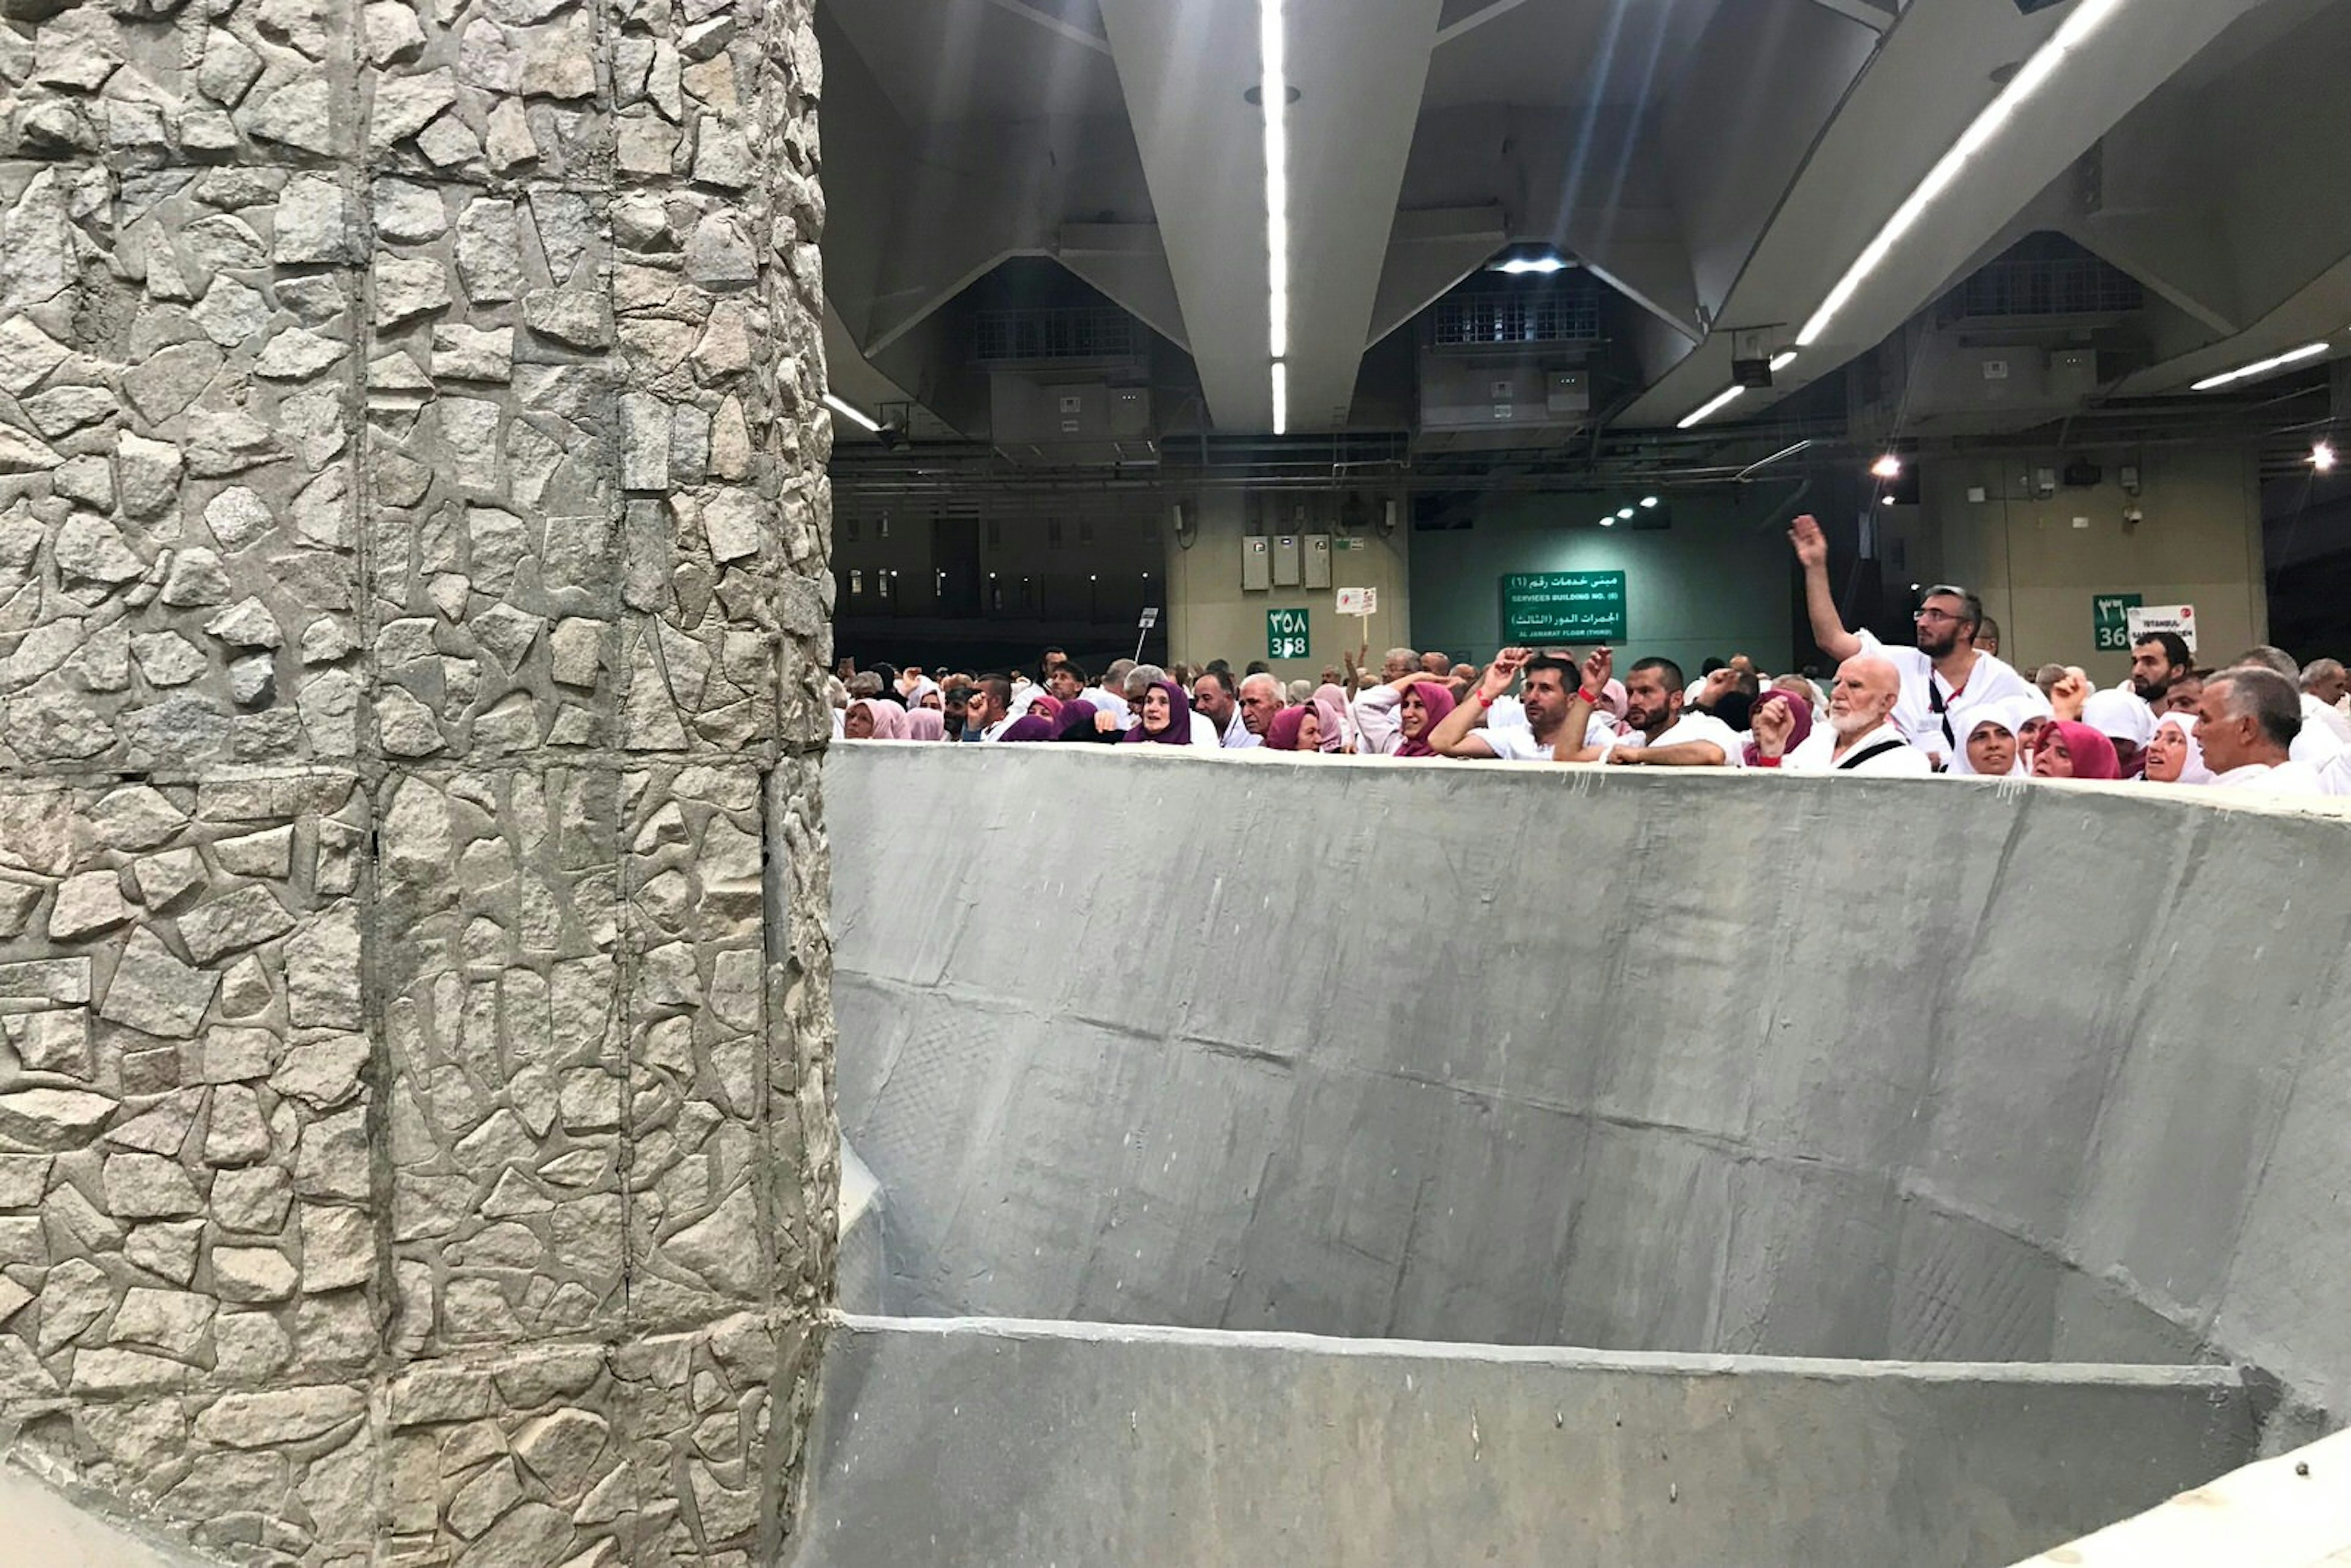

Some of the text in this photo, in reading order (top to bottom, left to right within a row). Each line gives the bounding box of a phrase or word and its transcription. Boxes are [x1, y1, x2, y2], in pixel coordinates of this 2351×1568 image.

[1529, 576, 1548, 588] رقم
[1551, 576, 1588, 586] خدمات
[2098, 599, 2126, 622] ٣٦
[1269, 612, 1306, 633] ٣٥٨
[1511, 613, 1553, 625] (الثالث)
[1580, 612, 1619, 625] الجمرات
[2099, 626, 2129, 647] 36
[1272, 637, 1305, 655] 358
